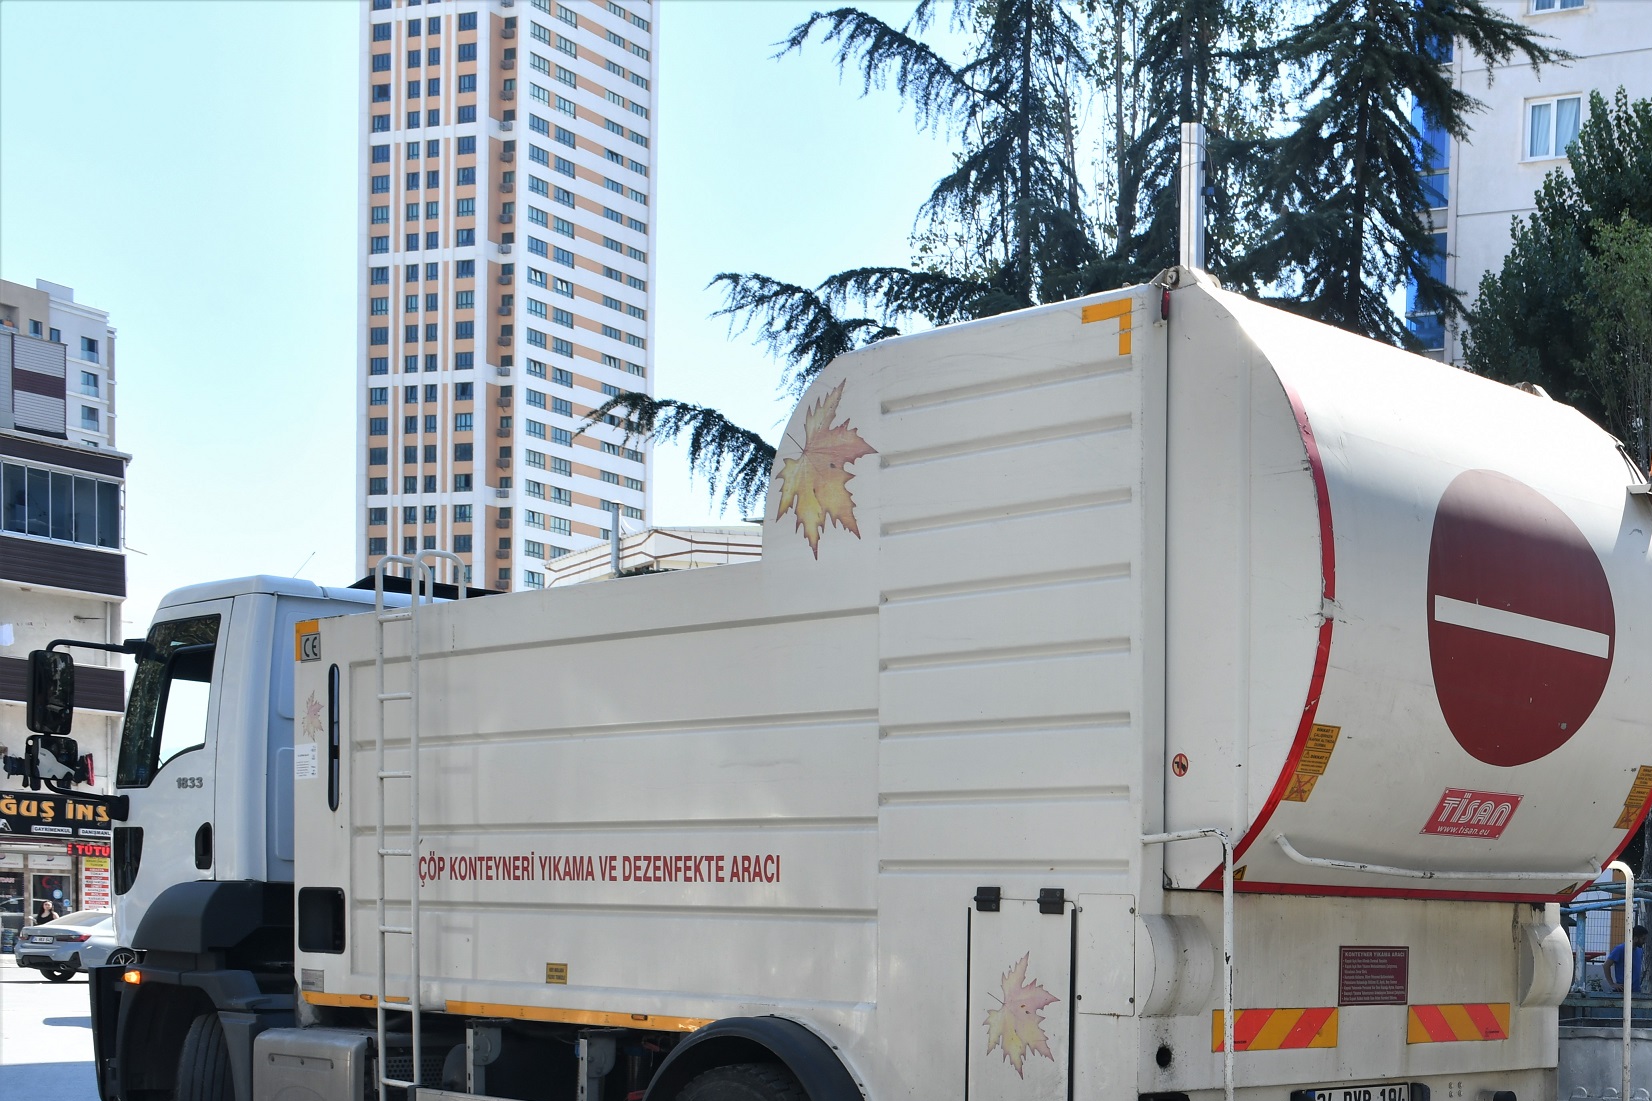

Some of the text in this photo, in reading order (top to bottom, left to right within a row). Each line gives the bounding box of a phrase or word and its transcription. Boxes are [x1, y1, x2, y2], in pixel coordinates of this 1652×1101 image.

[175, 776, 204, 789] 1833
[1437, 792, 1512, 827] TİSAN
[1437, 825, 1490, 836] www.tisan.eu
[418, 851, 781, 888] ÇÖP KONTEYNERİ YIKAMA VE DEZENFEKTE ARACI
